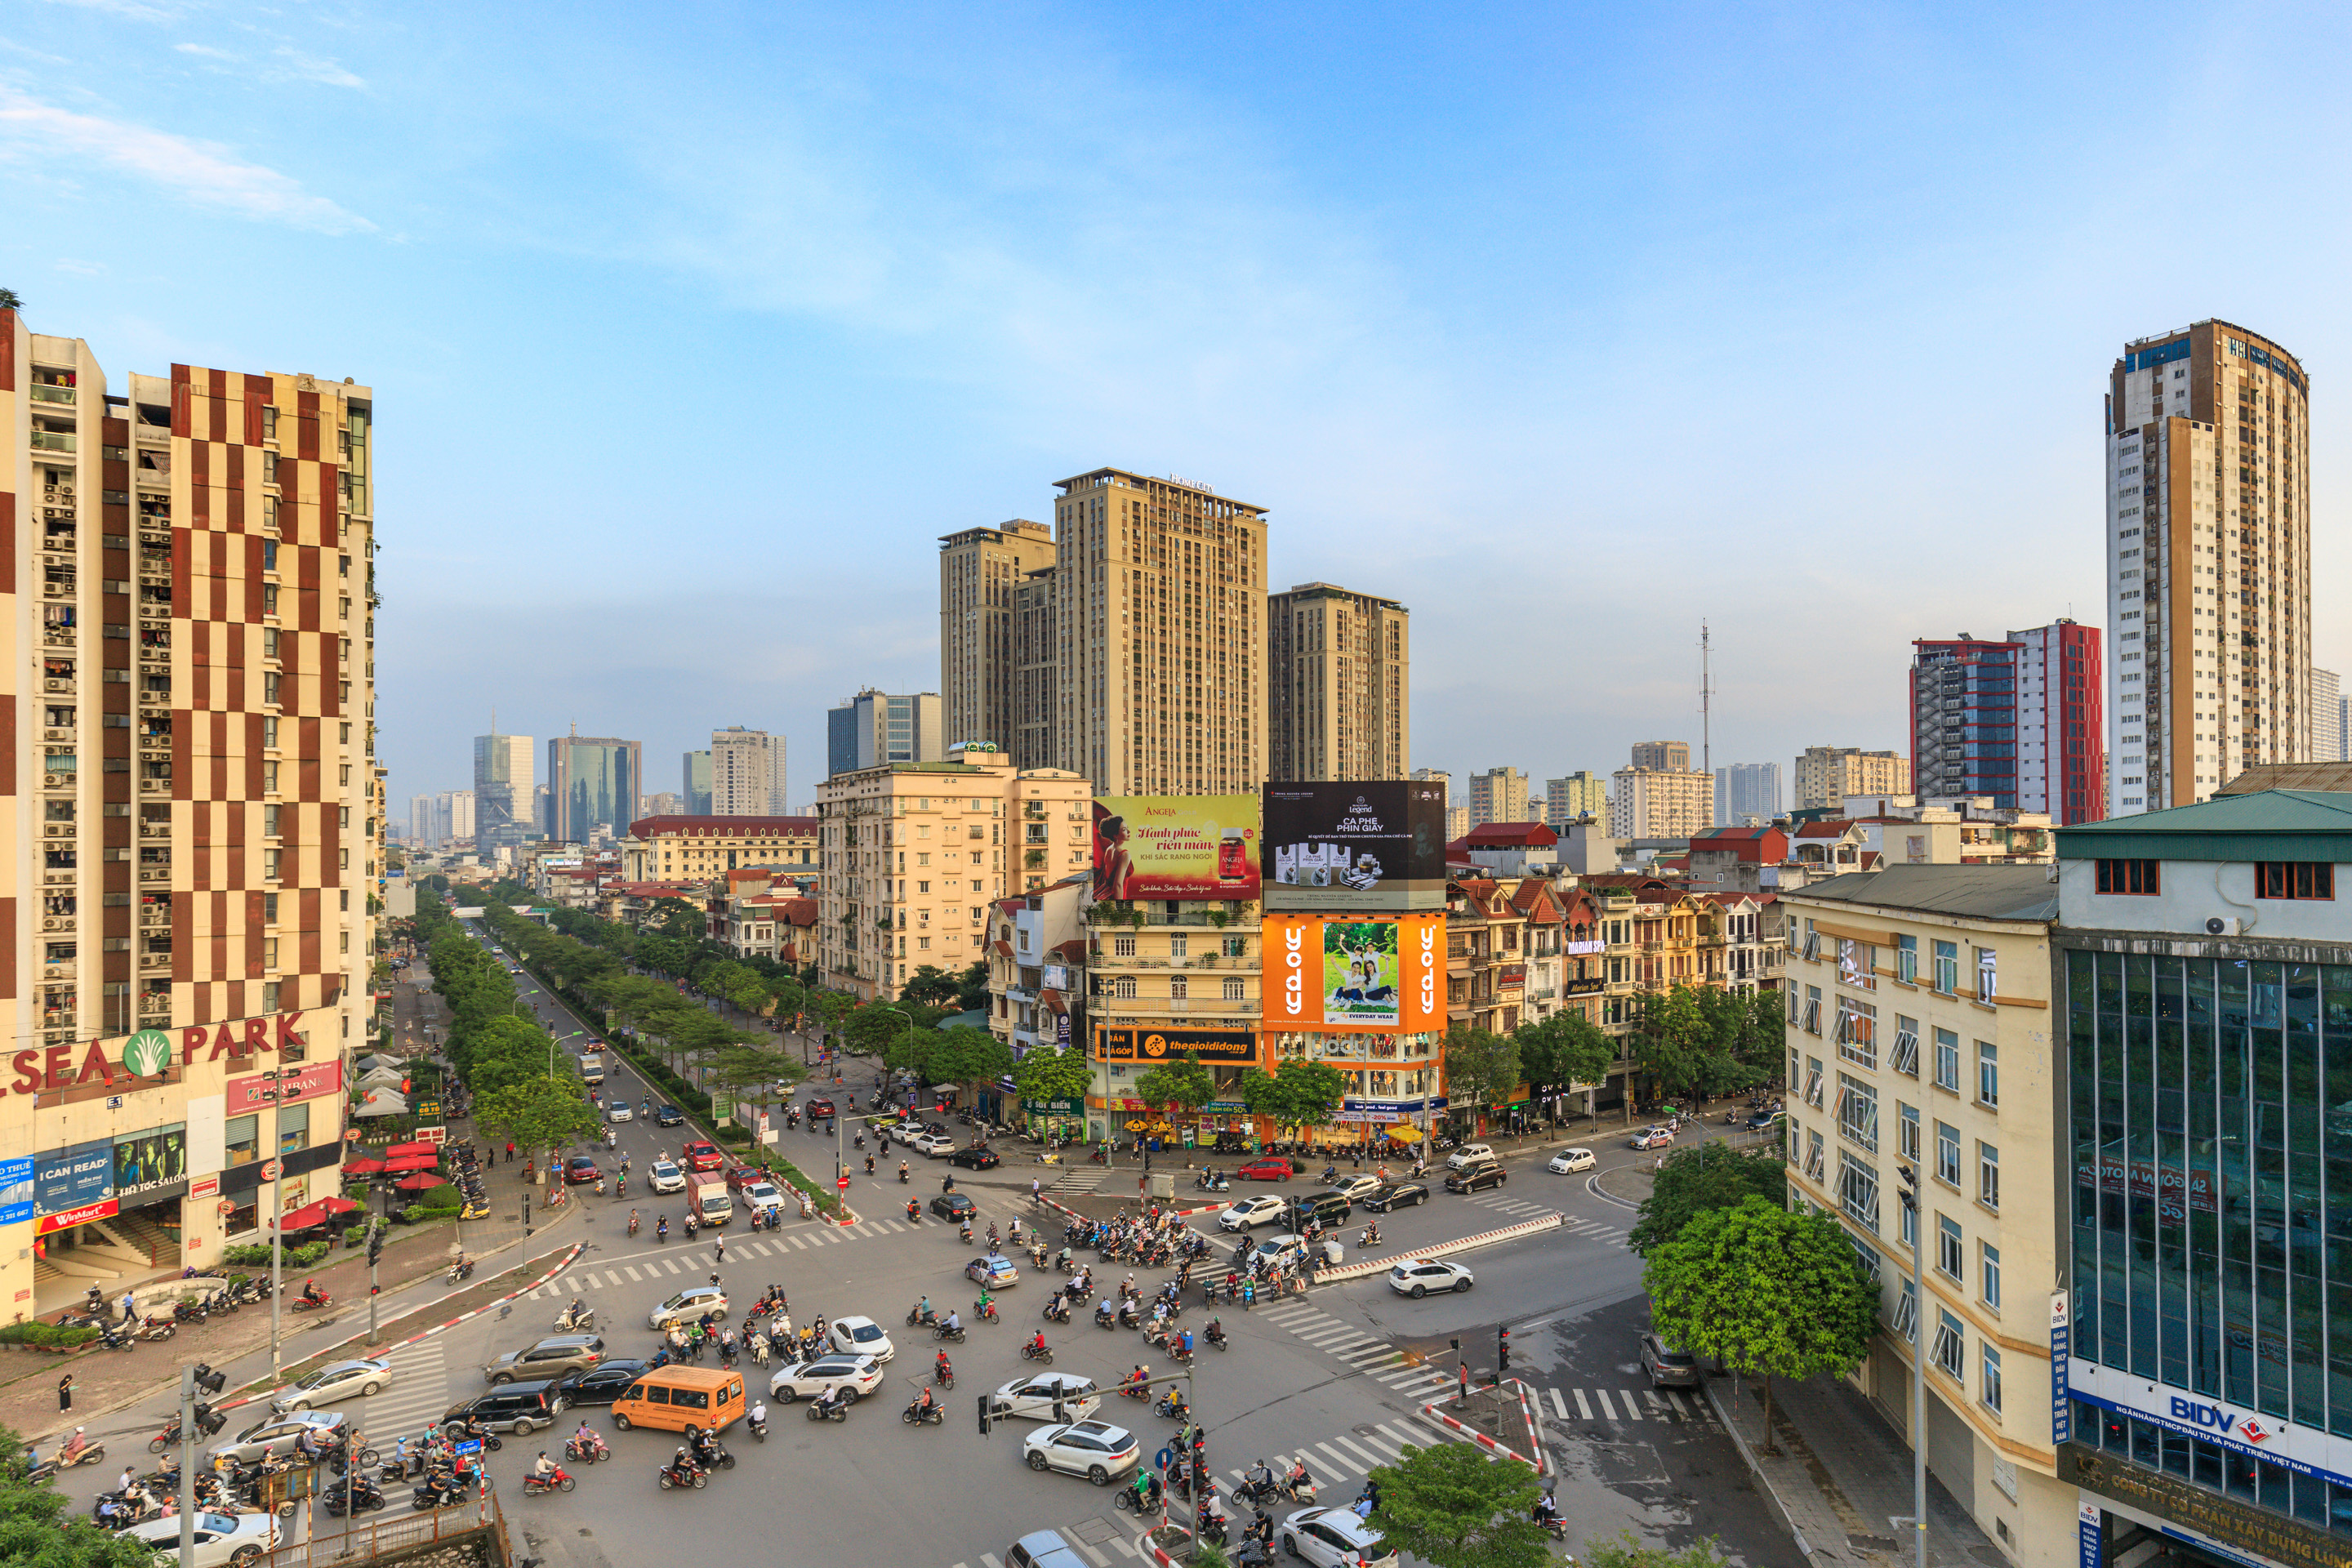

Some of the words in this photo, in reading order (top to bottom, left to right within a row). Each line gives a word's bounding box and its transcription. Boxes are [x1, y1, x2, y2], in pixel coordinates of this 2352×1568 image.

[1171, 473, 1195, 488] HOME
[1197, 480, 1215, 493] CITY
[1145, 806, 1176, 817] ANGELA
[1349, 806, 1372, 814] Legend
[1136, 827, 1172, 840] Hạnh
[1173, 827, 1200, 840] phúc
[1156, 840, 1181, 850] viên
[1569, 941, 1592, 955] MARIAN
[1593, 940, 1605, 953] SPA
[1285, 928, 1302, 1014] yody
[1421, 927, 1433, 1014] yody
[1570, 984, 1588, 992] Marian
[1590, 982, 1599, 992] Spa
[1116, 1048, 1132, 1056] GÓP
[1169, 1040, 1248, 1054] thegioididong
[11, 1037, 114, 1094] SEA
[184, 1012, 306, 1066] PARK
[1541, 1083, 1562, 1092] OWN
[1542, 1094, 1560, 1102] OWN
[1200, 1122, 1214, 1130] GÓP
[7, 1160, 31, 1174] THUÊ
[39, 1173, 44, 1182] I
[45, 1166, 71, 1179] CAN
[74, 1159, 105, 1174] READ
[158, 1174, 187, 1187] SALON
[2052, 1314, 2066, 1323] BIDV
[2053, 1330, 2066, 1340] NGÂN
[2053, 1341, 2067, 1352] HÀNG
[2053, 1352, 2067, 1363] TMCP
[2057, 1375, 2064, 1384] TƯ
[2057, 1385, 2064, 1395] VÀ
[2055, 1397, 2066, 1408] PHÁT
[2171, 1396, 2235, 1432] BIDV
[2056, 1419, 2066, 1431] VIỆT
[2056, 1431, 2067, 1441] NAM
[2292, 1461, 2311, 1474] NAM
[2080, 1512, 2098, 1523] BIDV
